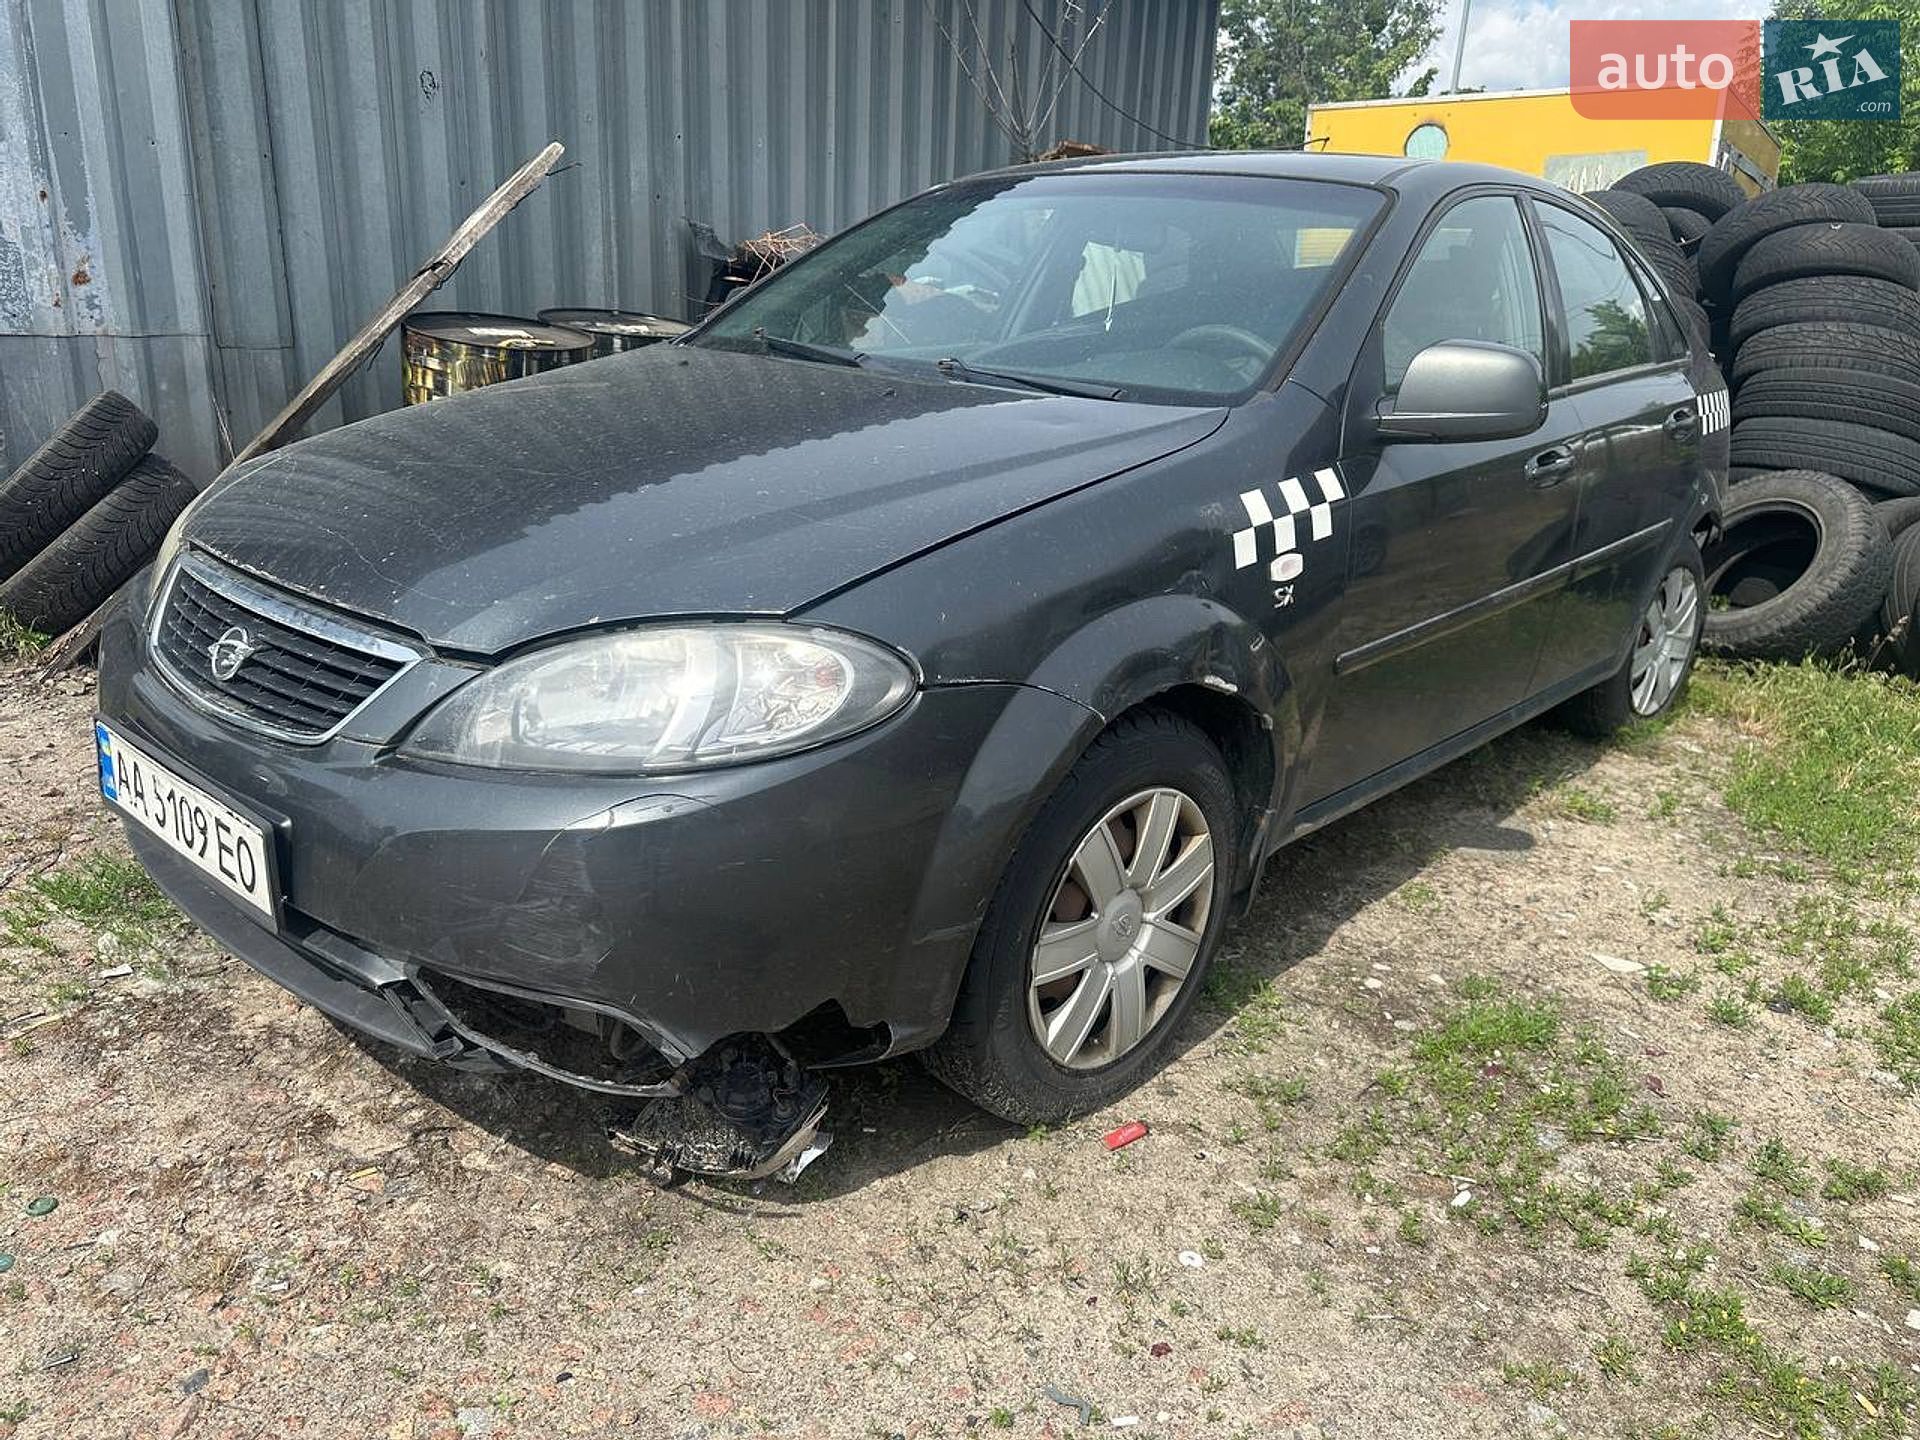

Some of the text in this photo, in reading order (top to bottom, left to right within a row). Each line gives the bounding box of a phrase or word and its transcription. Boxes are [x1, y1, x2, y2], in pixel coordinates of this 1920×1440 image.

[1274, 584, 1295, 608] SX
[118, 752, 149, 817] AA
[215, 816, 256, 893] EO
